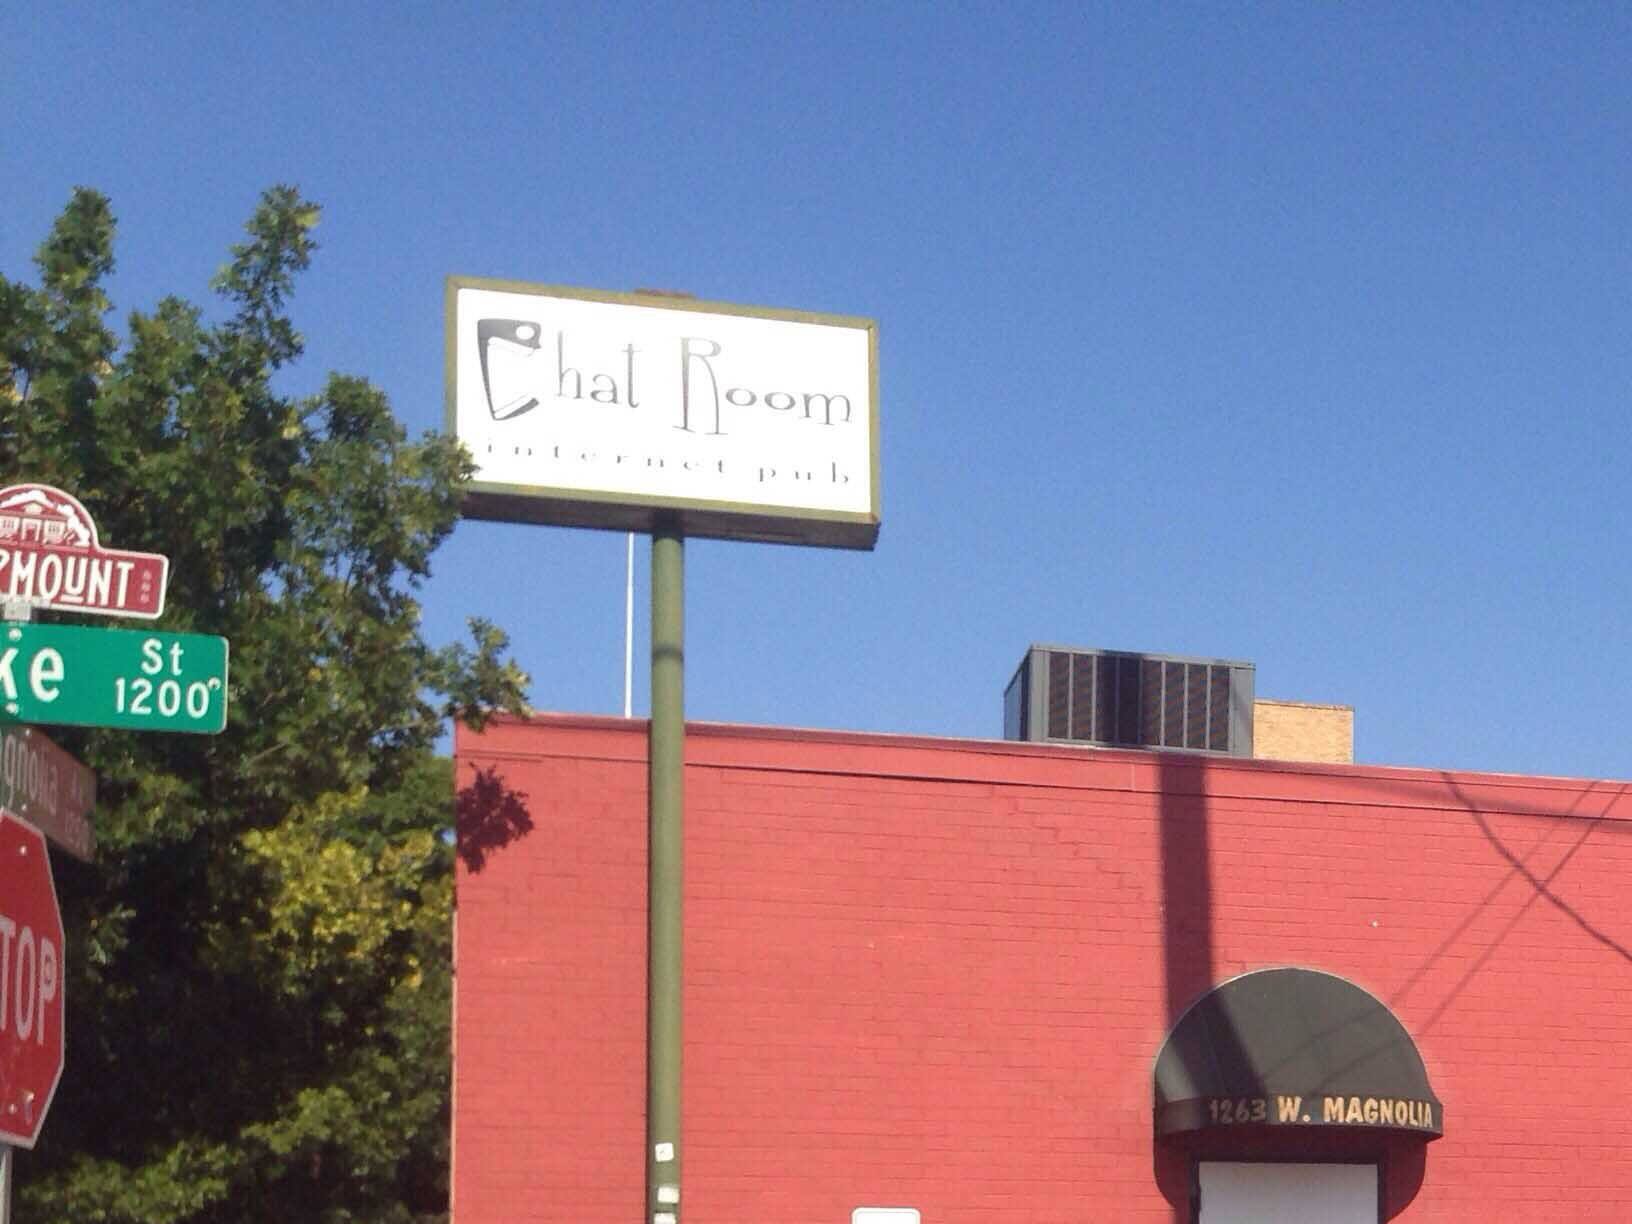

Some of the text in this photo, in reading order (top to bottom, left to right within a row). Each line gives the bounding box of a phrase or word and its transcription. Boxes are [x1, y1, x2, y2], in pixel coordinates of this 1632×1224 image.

[477, 318, 853, 435] Chat Room
[486, 444, 851, 484] internet pub
[141, 638, 185, 677] St
[115, 677, 210, 719] 1200
[1208, 1095, 1433, 1129] 1263 W. MAGNOLIA
